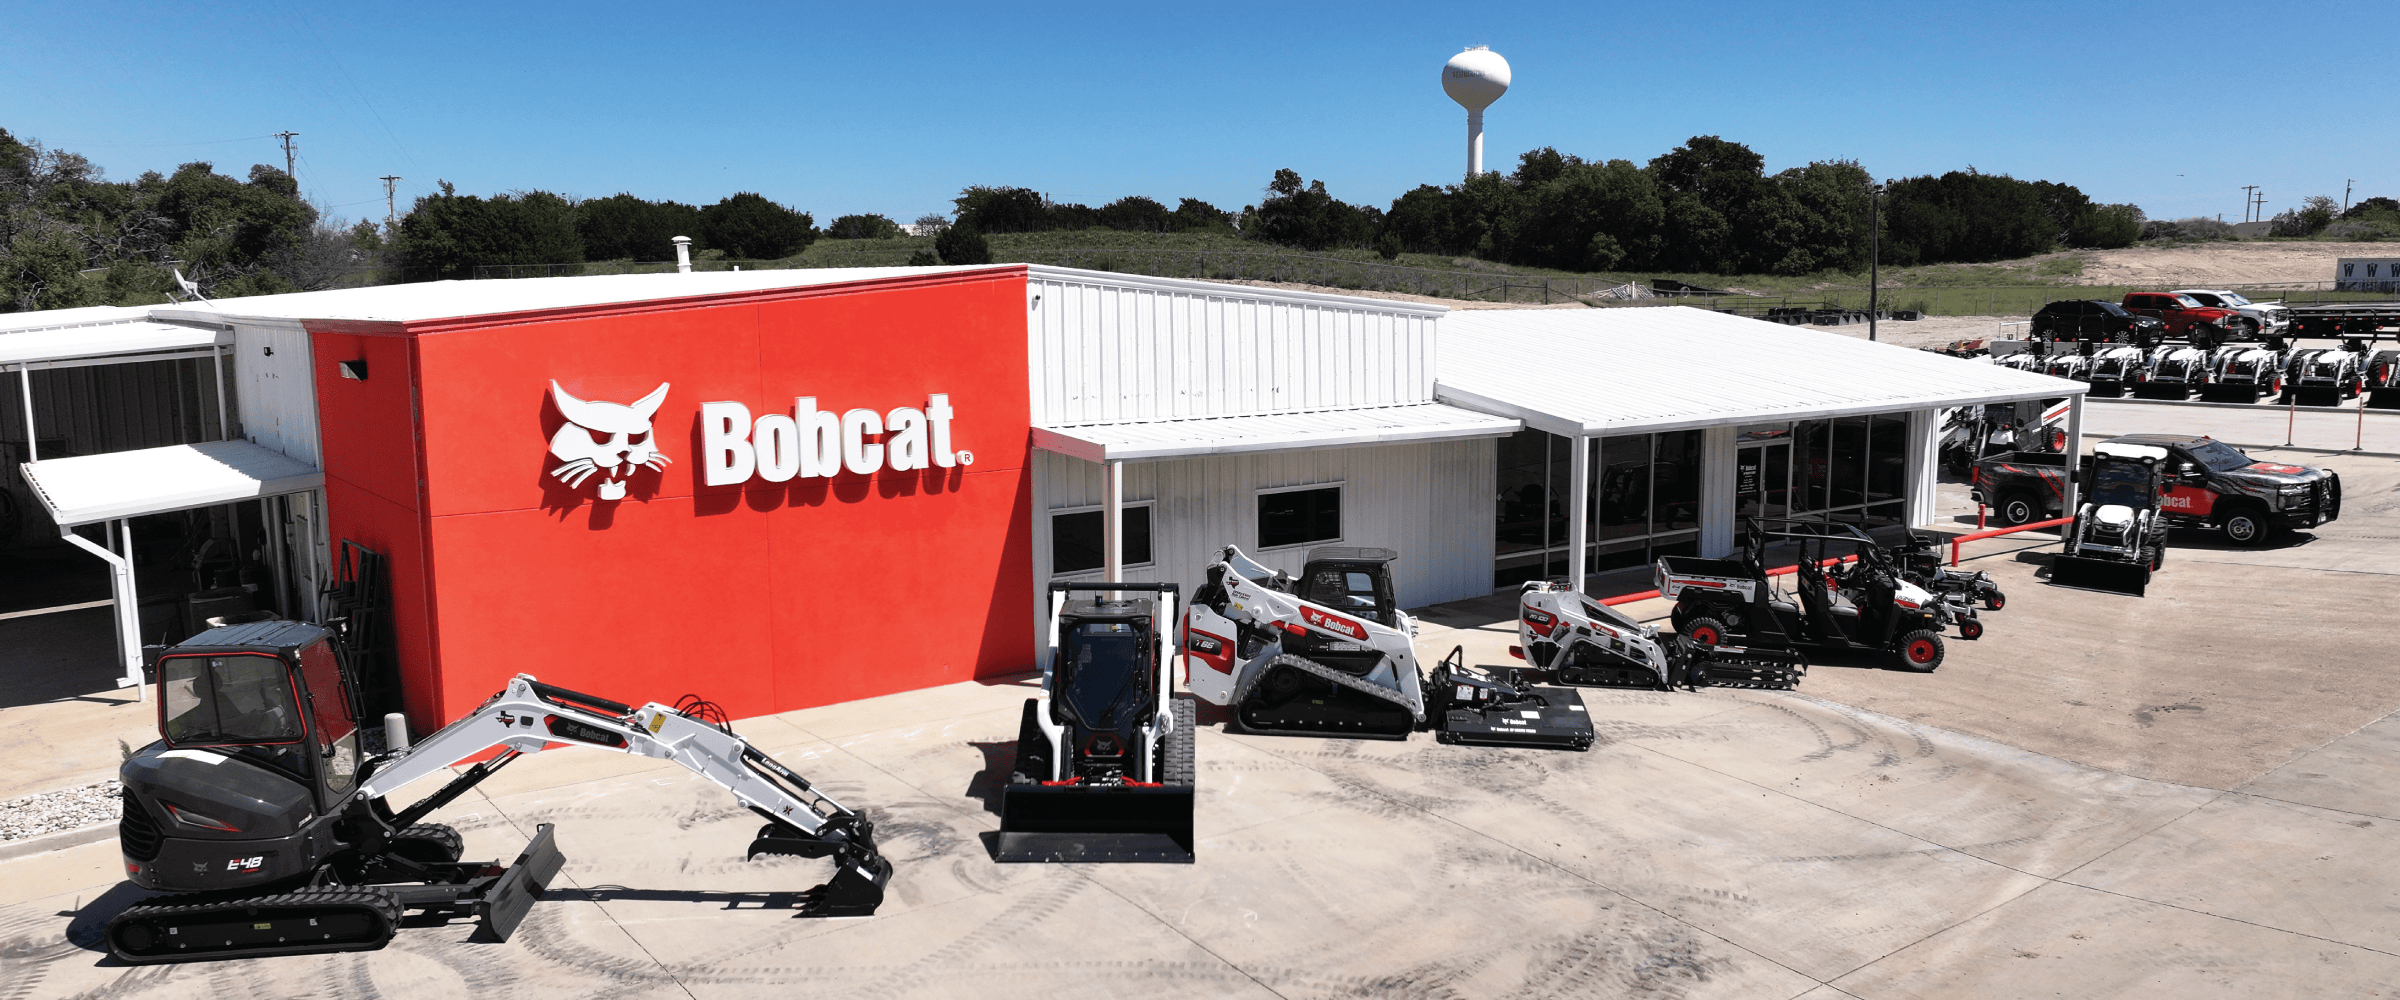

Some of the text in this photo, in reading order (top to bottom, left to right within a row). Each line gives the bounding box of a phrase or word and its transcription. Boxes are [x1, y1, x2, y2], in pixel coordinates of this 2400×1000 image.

[1324, 617, 1355, 635] Bobcat
[579, 727, 610, 743] Bobcat
[226, 856, 264, 871] E48
